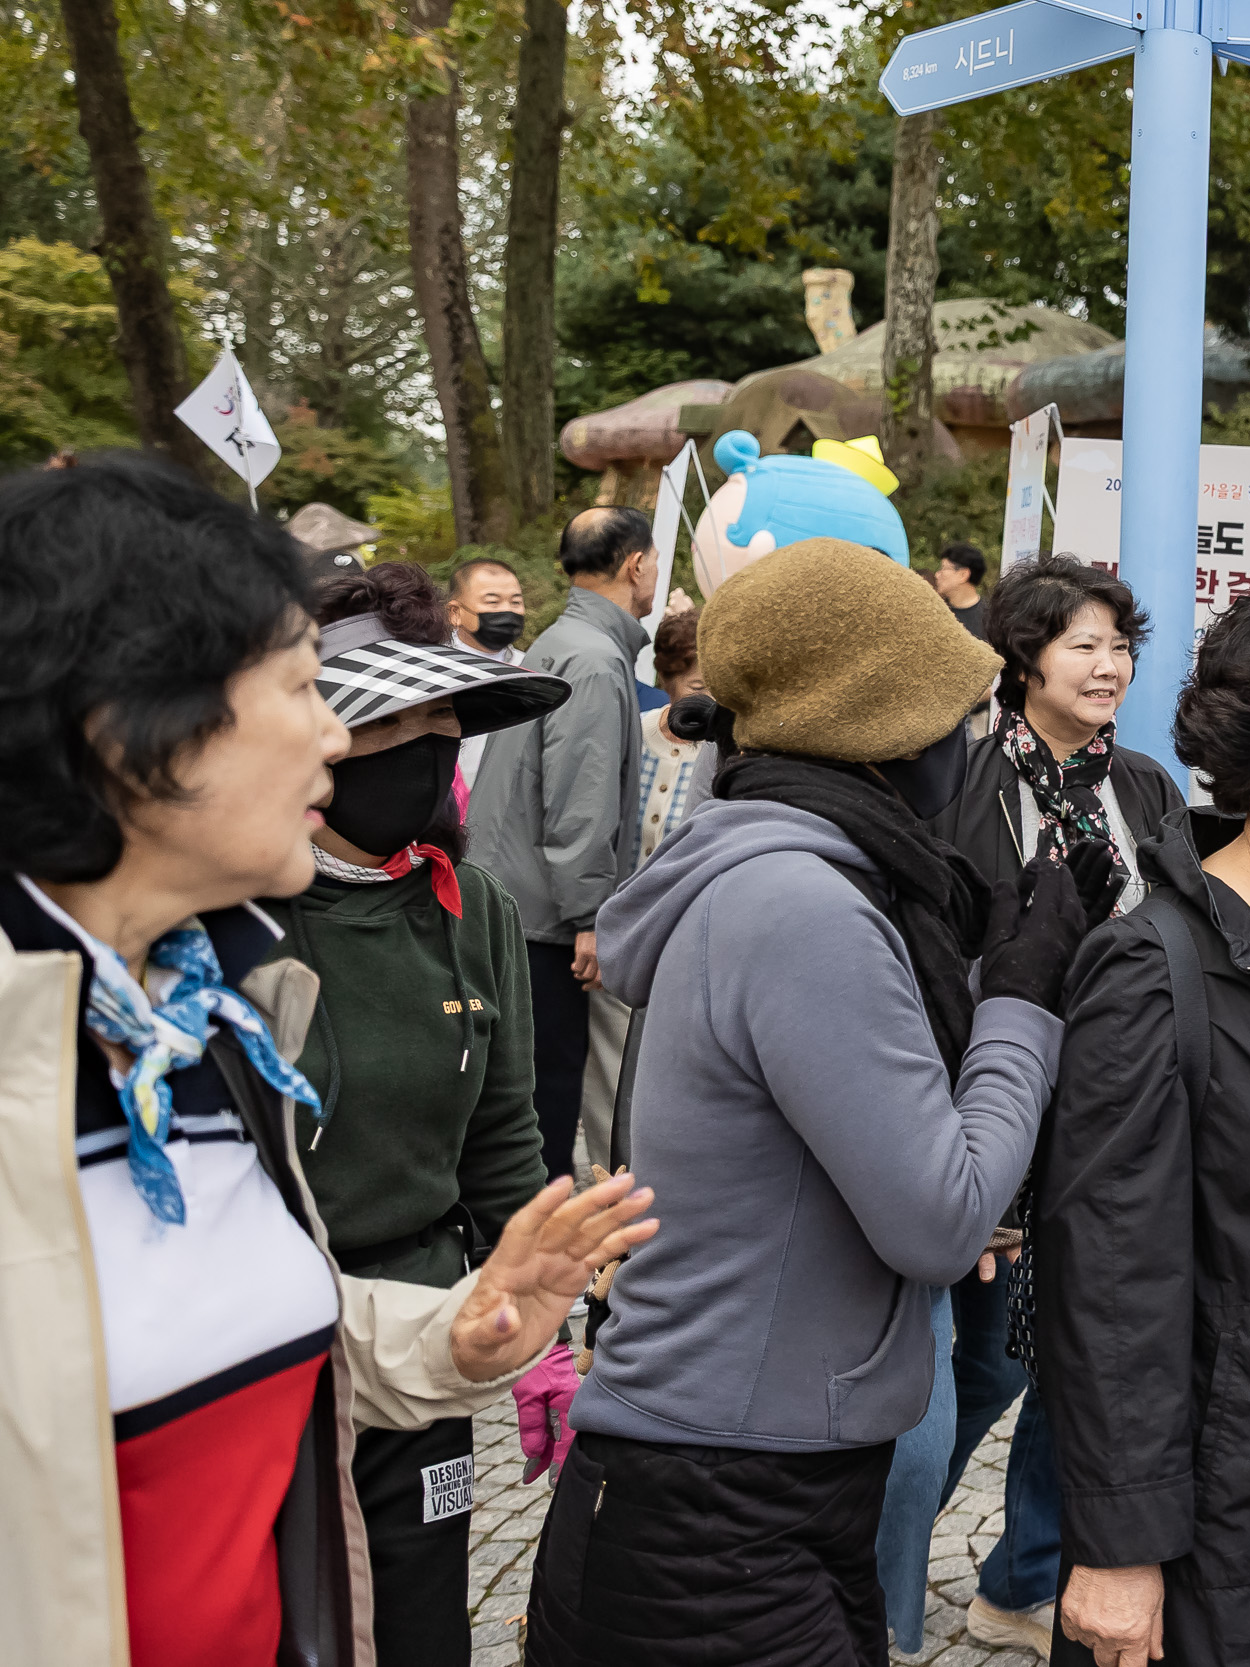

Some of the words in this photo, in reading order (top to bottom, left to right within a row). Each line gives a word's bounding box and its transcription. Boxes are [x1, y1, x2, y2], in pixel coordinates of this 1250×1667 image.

[955, 28, 1014, 76] 시드니
[902, 65, 924, 82] 8,324
[924, 61, 938, 75] km
[1105, 478, 1122, 491] 20
[1203, 483, 1242, 500] 가을길
[1197, 521, 1245, 556] 늘도
[442, 998, 484, 1014] GOWER
[429, 1460, 468, 1486] DESIGN
[431, 1479, 461, 1496] THINKING
[431, 1485, 474, 1516] VISUAL
